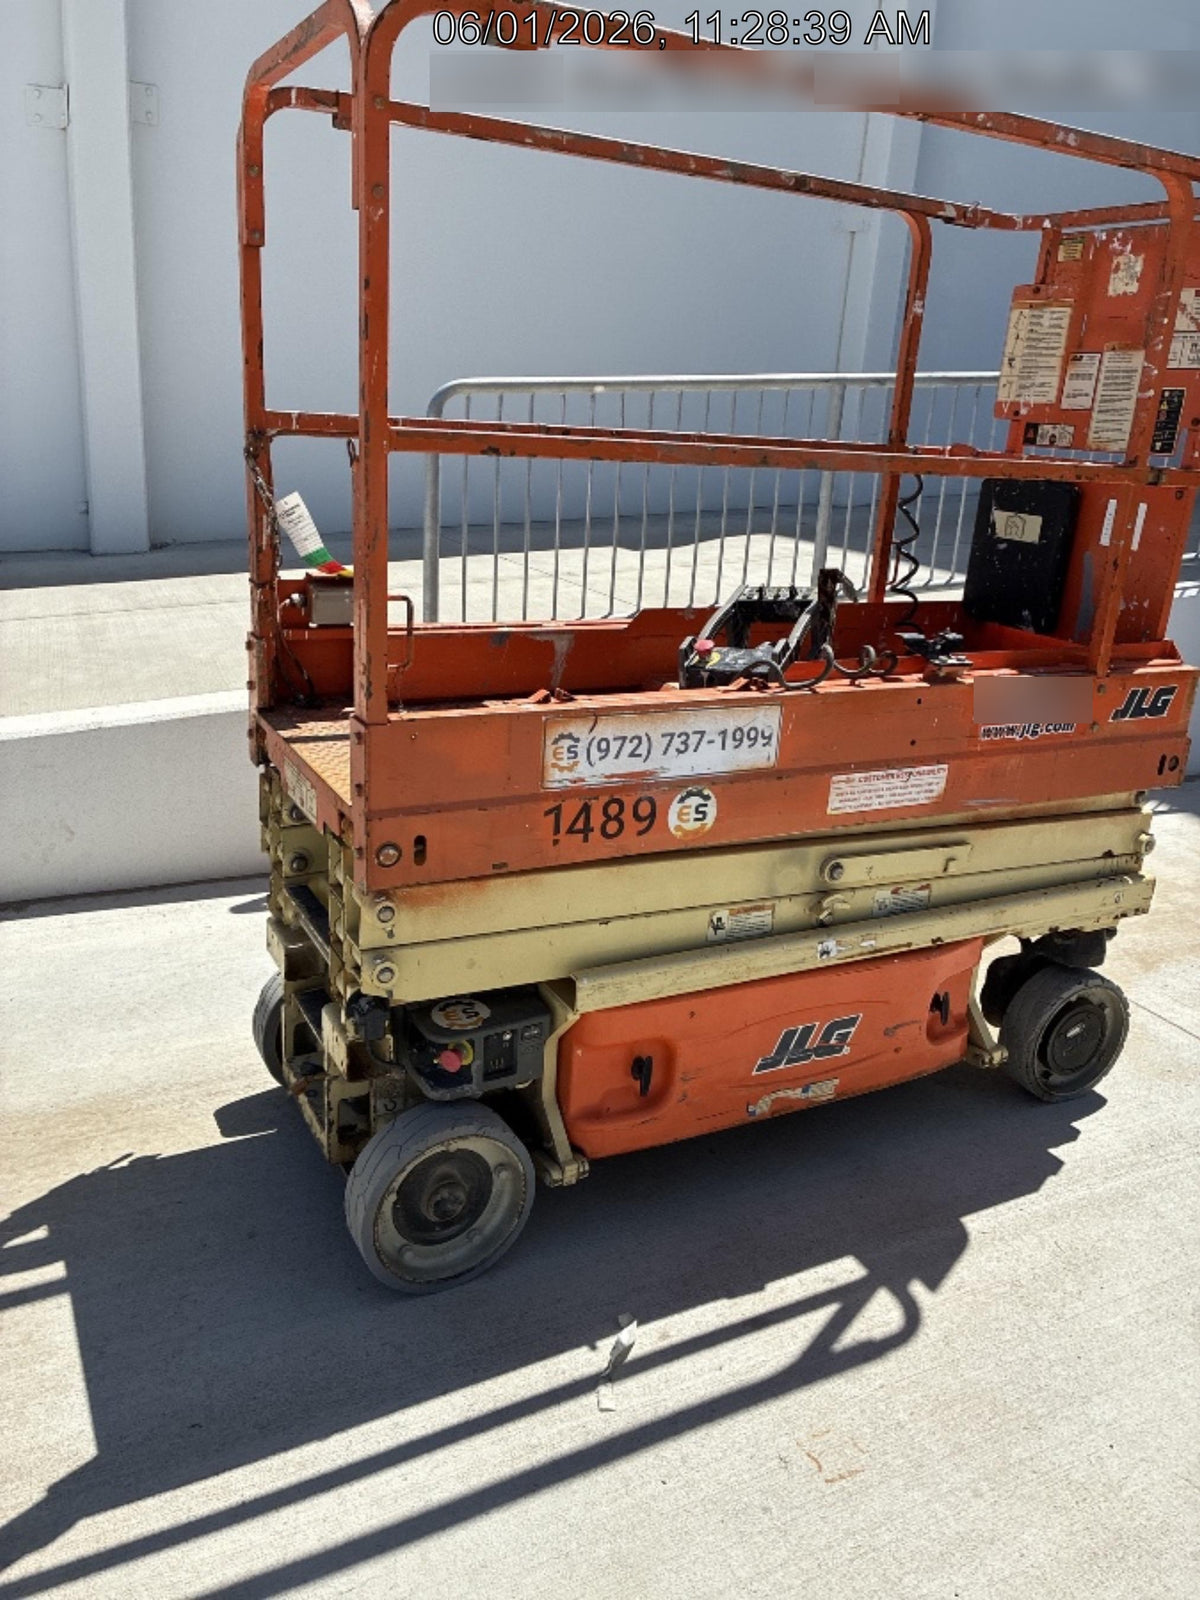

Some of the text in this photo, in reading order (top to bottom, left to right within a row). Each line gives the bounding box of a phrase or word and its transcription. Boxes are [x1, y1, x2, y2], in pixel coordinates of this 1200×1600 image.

[1109, 685, 1178, 721] JLG
[981, 722, 1075, 740] www.jlg.com
[586, 732, 652, 767] (972)
[544, 795, 657, 846] 1489
[752, 1013, 863, 1076] JLG
